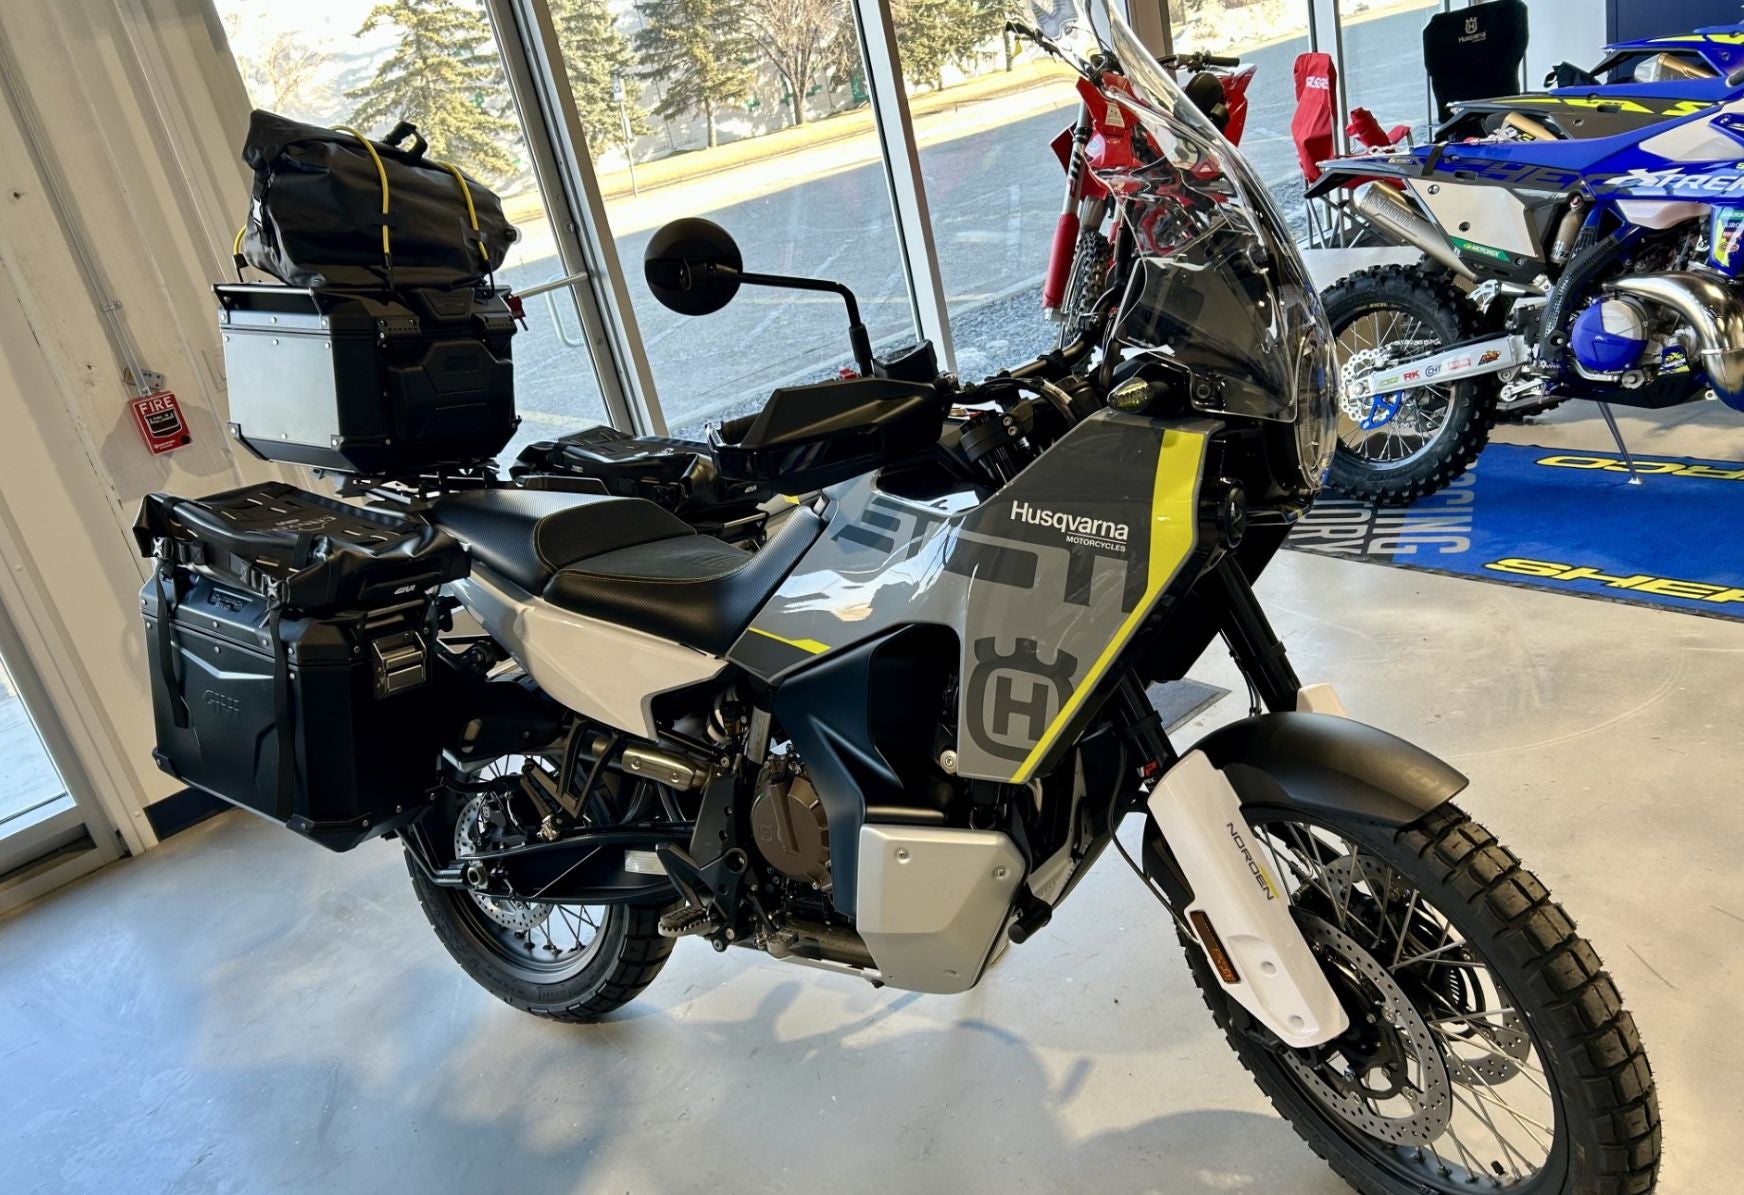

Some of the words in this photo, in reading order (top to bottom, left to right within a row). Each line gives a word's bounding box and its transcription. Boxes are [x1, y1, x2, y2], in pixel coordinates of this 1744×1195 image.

[1404, 370, 1420, 381] RK
[138, 396, 174, 415] FIRE
[1010, 500, 1129, 540] Husqvarna
[1065, 535, 1126, 552] MOTORCYCLES
[1226, 822, 1274, 901] NORDEN
